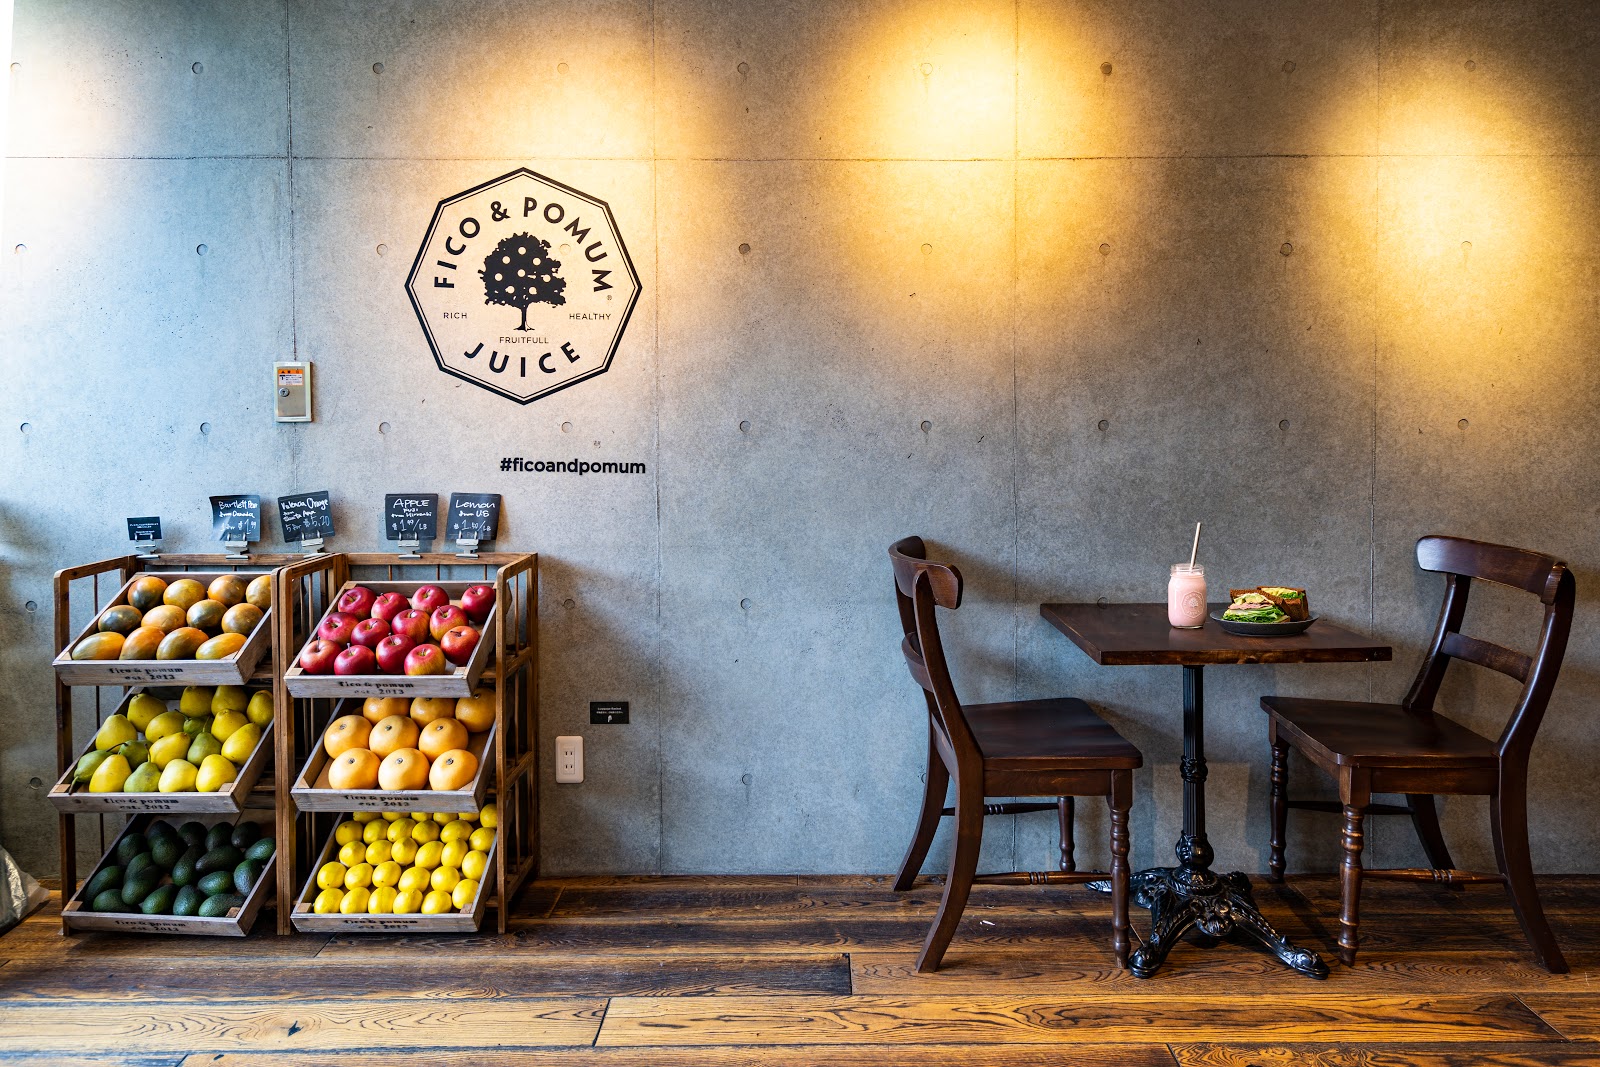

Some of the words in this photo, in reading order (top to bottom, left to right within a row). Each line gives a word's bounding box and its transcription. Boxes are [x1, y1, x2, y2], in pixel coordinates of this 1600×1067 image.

[434, 217, 480, 288] FICO
[490, 200, 511, 222] &
[524, 196, 614, 292] POMUM
[464, 342, 580, 378] JUICE
[500, 458, 646, 476] #ficoandpomum
[392, 498, 430, 508] APPLE
[456, 500, 496, 508] Lemon
